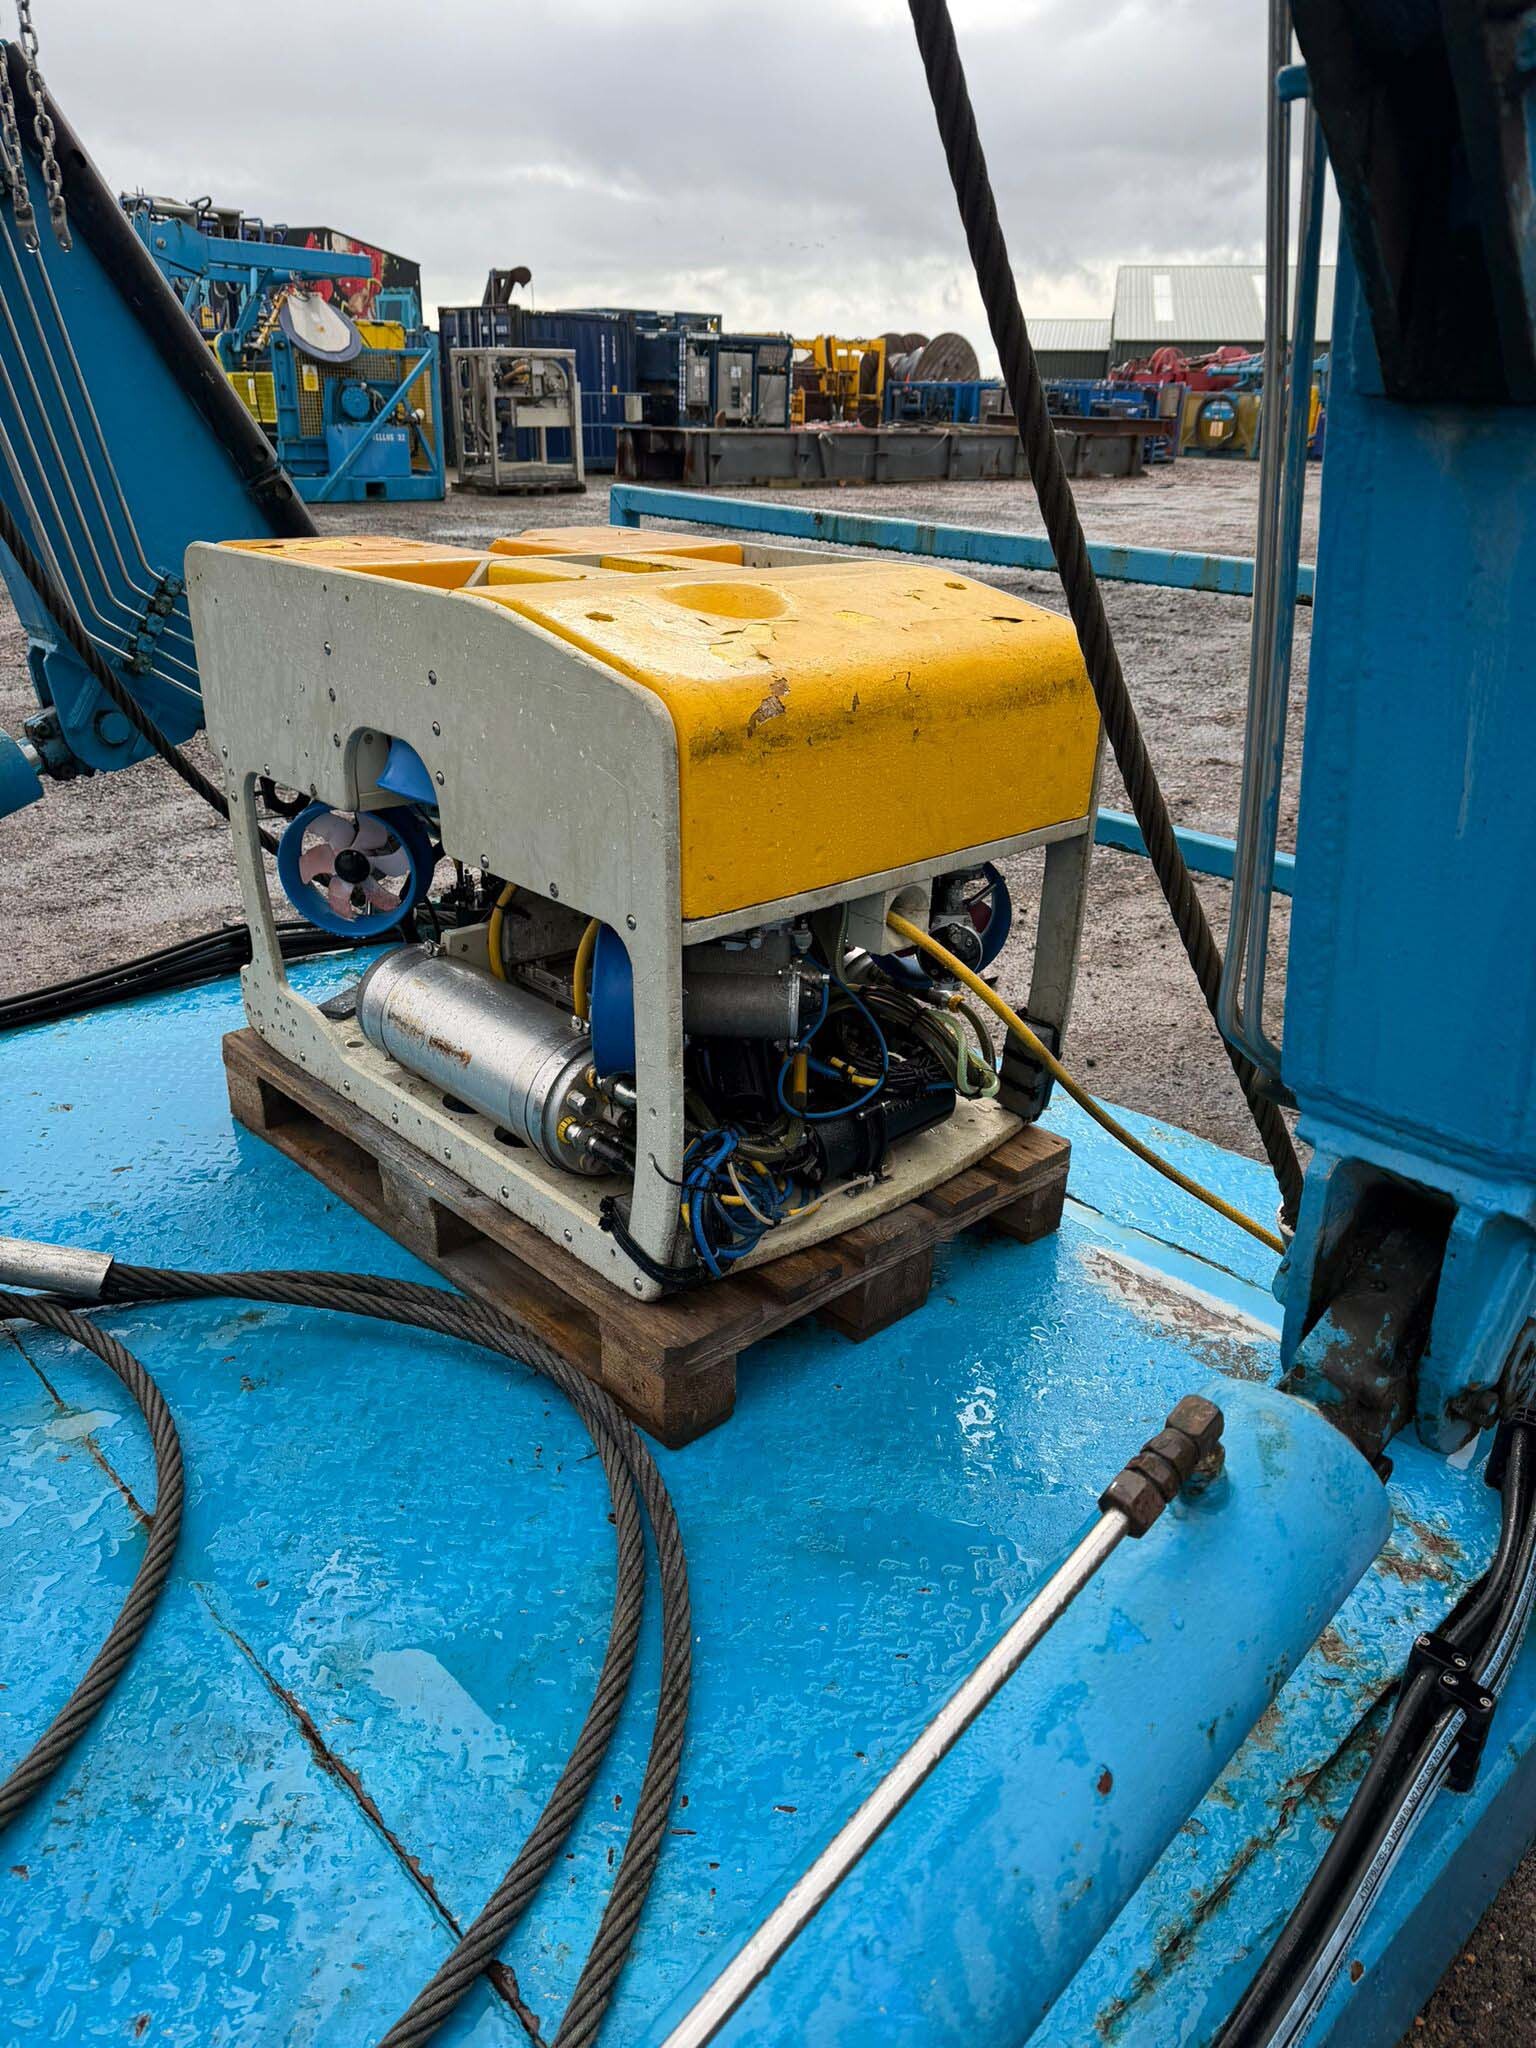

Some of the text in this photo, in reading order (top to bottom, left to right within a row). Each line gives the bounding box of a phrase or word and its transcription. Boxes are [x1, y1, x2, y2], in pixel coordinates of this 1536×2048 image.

[1431, 1748, 1442, 1762] EN
[1407, 1790, 1419, 1806] DN
[1388, 1813, 1407, 1840] MSHA
